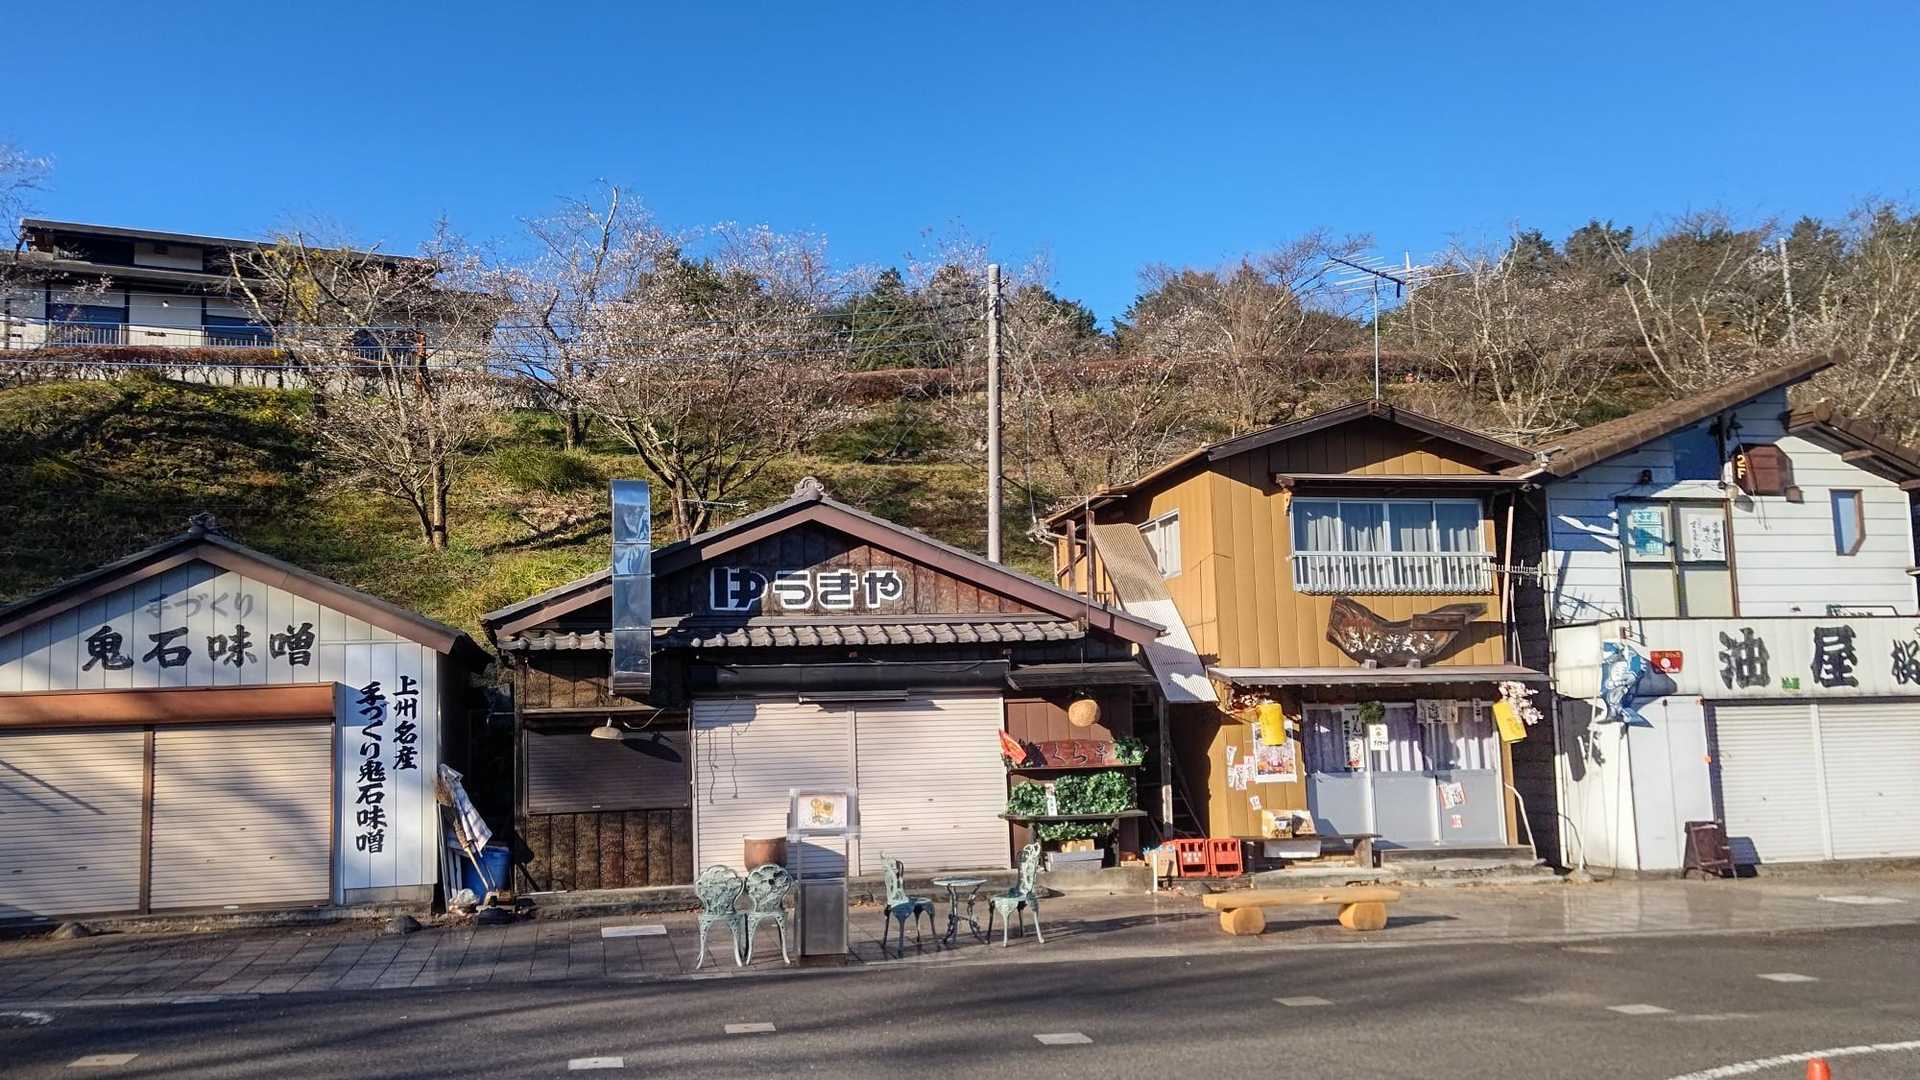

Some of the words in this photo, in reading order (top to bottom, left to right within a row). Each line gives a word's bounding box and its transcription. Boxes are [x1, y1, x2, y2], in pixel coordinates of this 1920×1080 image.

[1735, 454, 1747, 480] 2F
[146, 593, 256, 618] 手づくり
[710, 568, 903, 612] ゆうきや
[83, 623, 316, 671] 鬼石味噌
[392, 674, 420, 771] 上州名産
[355, 681, 387, 854] 手づくり鬼石味噌
